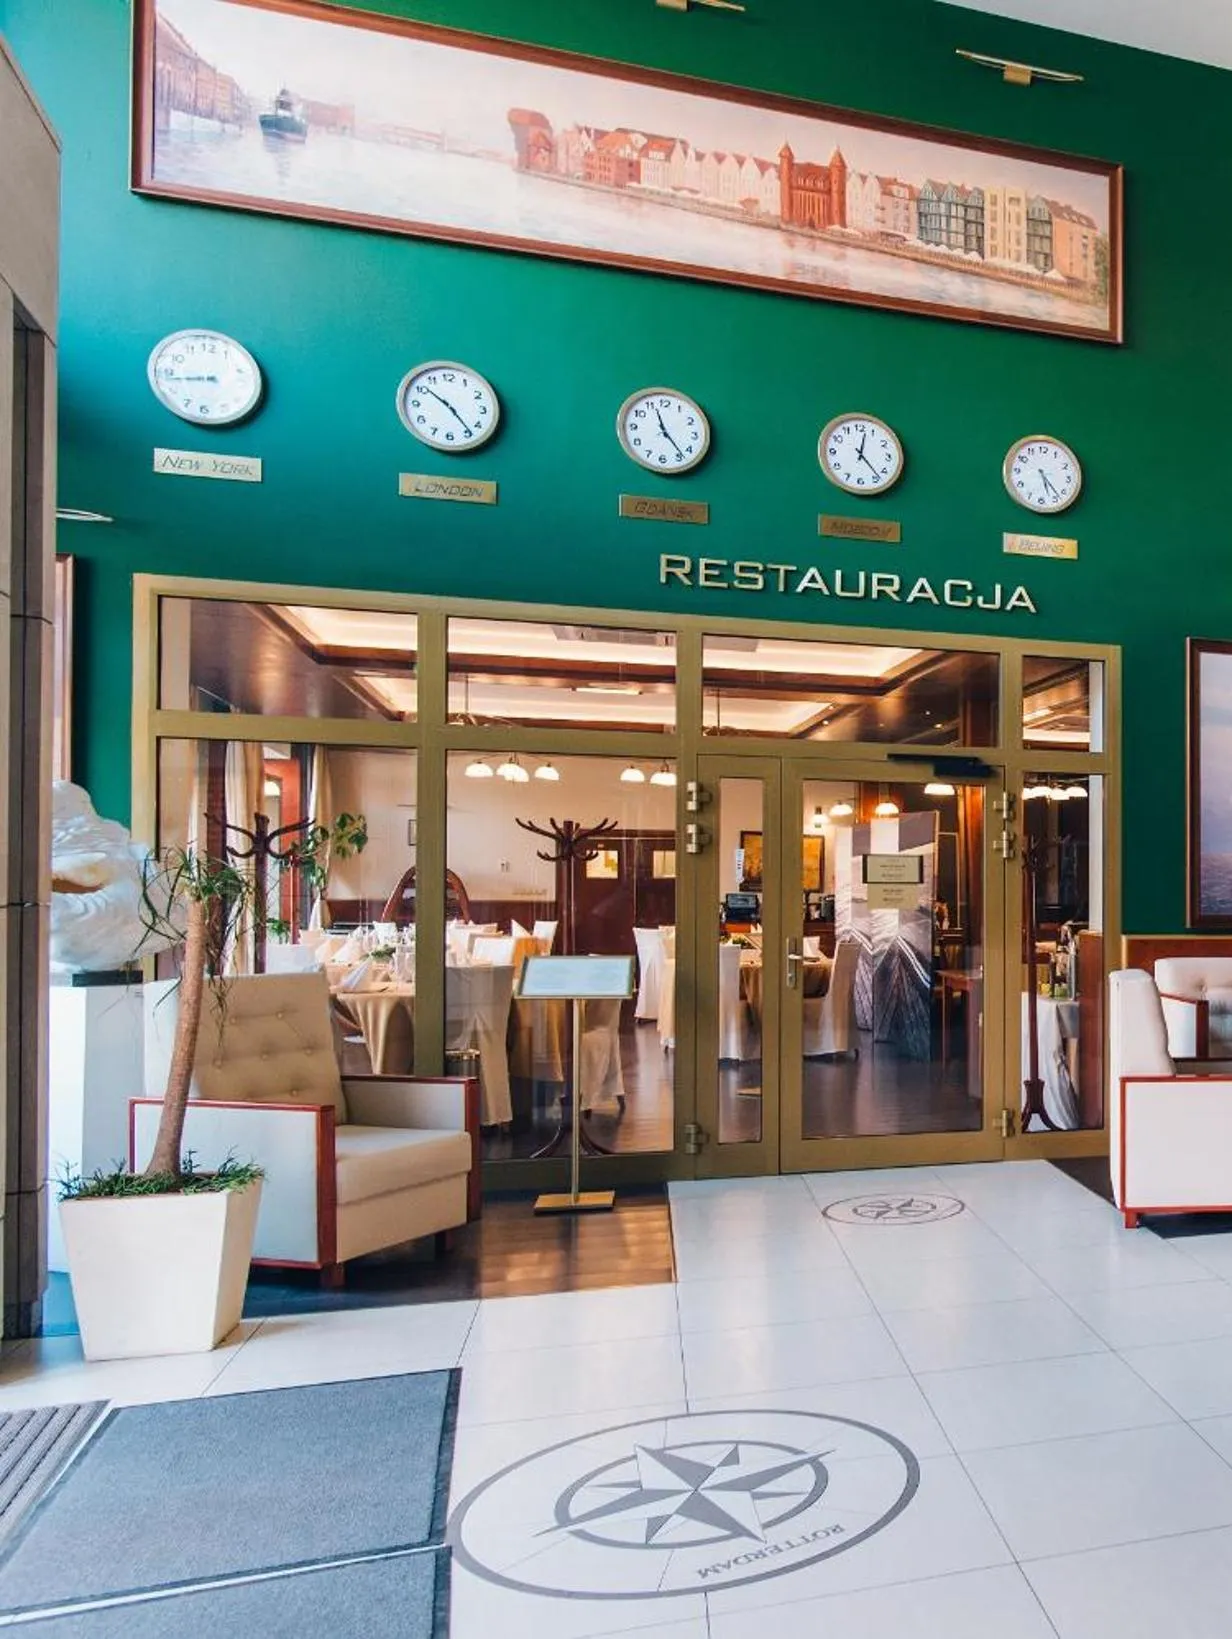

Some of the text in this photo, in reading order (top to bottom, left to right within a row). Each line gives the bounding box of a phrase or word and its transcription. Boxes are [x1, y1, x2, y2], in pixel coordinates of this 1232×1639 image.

[162, 455, 253, 476] NEW YORK
[415, 483, 484, 497] LONDON
[659, 553, 1037, 613] RESTAURACJA
[697, 1524, 846, 1579] ROTTERDAM
